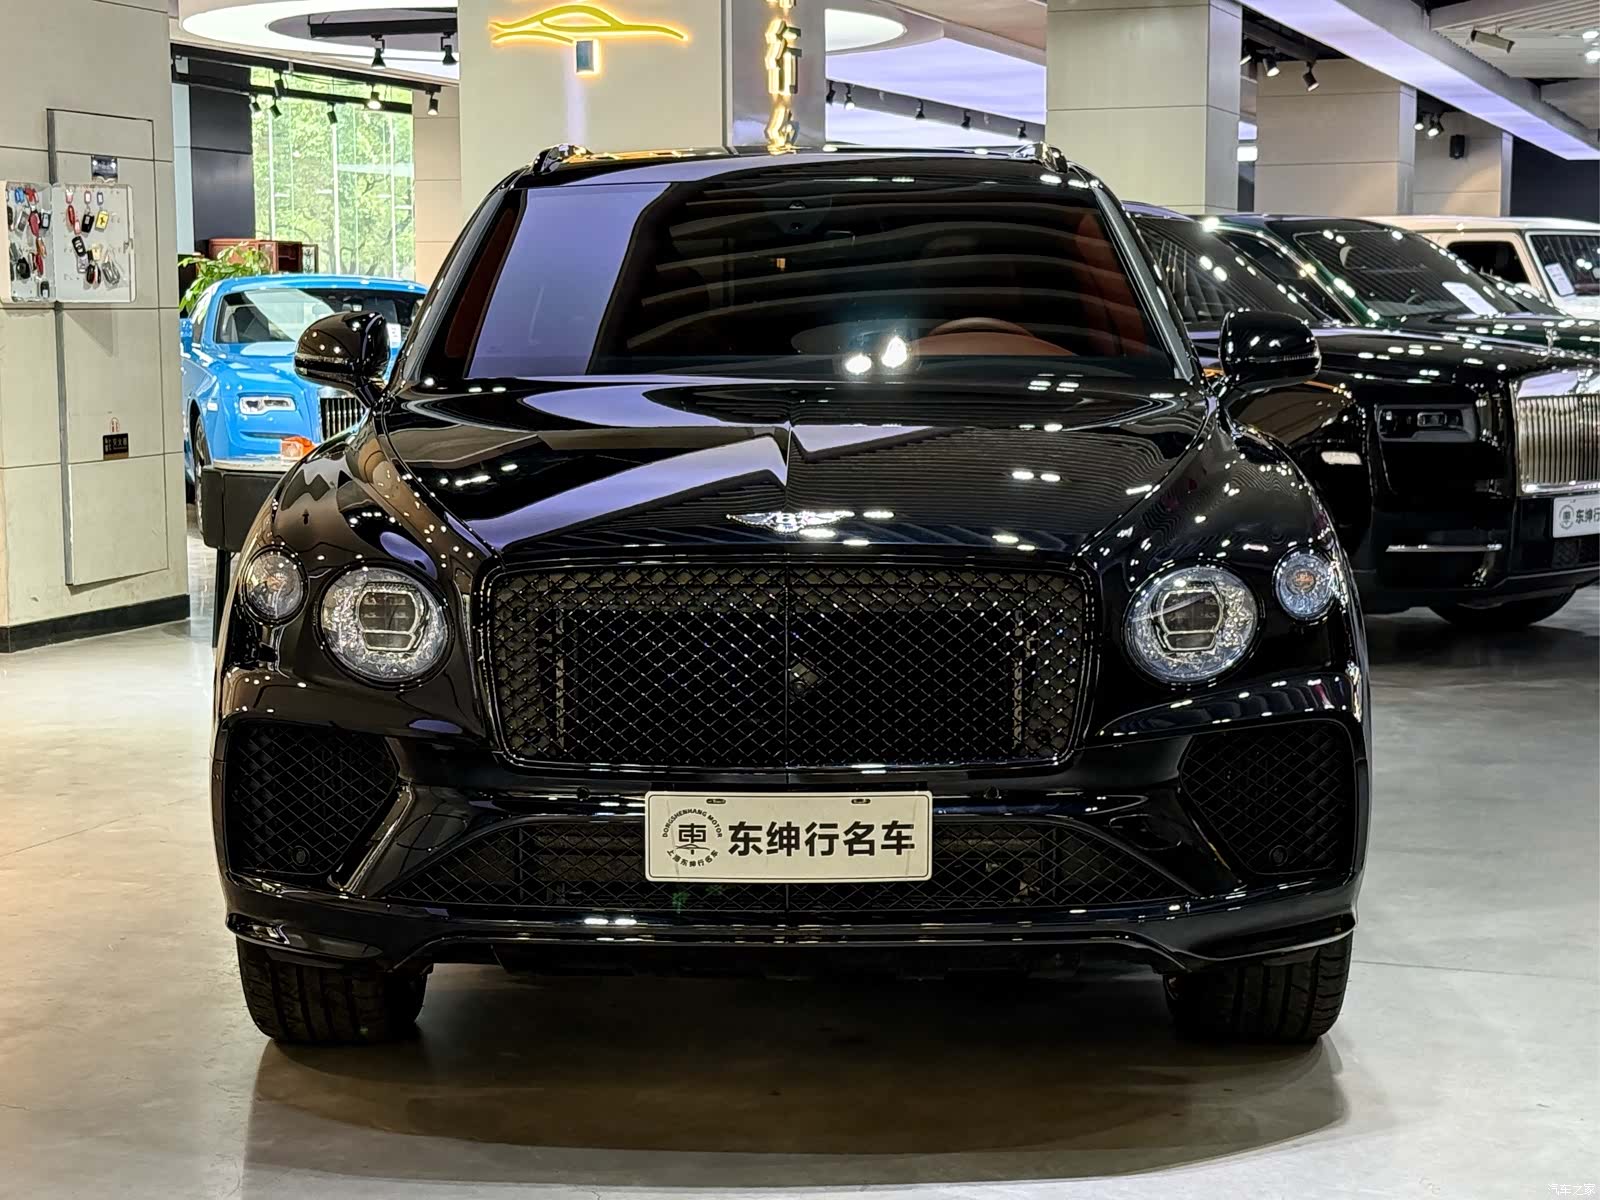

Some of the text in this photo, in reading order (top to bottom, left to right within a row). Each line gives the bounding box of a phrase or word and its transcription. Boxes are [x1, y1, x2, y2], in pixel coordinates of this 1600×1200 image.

[662, 809, 723, 838] DONGSHENHANG MOTOR
[728, 820, 915, 857] 东绅行名车
